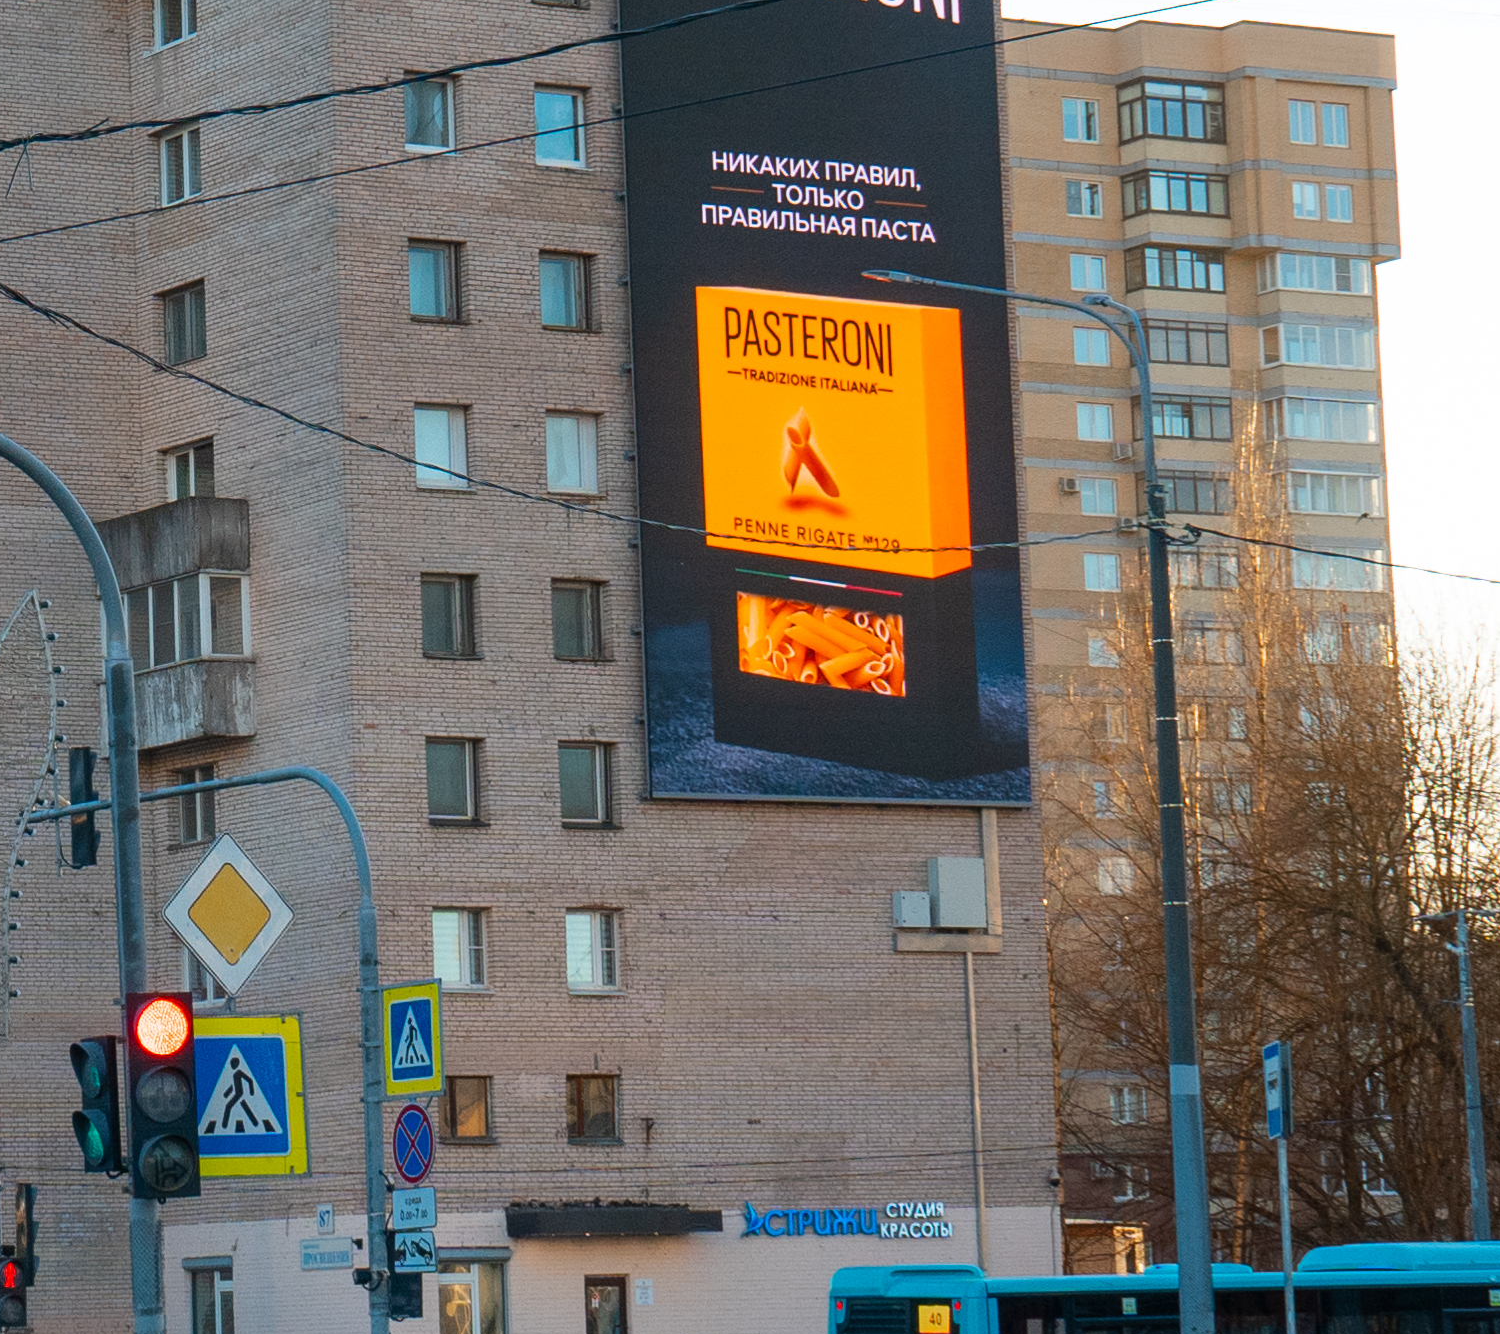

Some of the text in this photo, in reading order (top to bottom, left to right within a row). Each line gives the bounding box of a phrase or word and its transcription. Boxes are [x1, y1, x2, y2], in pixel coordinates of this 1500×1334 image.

[712, 150, 922, 192] НИКАКИХ ПРАВИЛ,
[771, 183, 865, 211] ТОЛЬКО
[701, 203, 937, 243] ПРАВИЛЬНАЯ ПАСТА
[724, 306, 893, 377] PASTERONI
[741, 368, 879, 395] TRADIZIONE ITALIANA
[734, 517, 789, 539] PENNE
[797, 526, 857, 547] RIGATE
[318, 1209, 331, 1228] 87
[764, 1208, 877, 1237] СТРИЖИ
[886, 1202, 945, 1218] СТУДИЯ
[880, 1222, 953, 1238] КРАСОТЫ
[929, 1312, 942, 1326] 40
